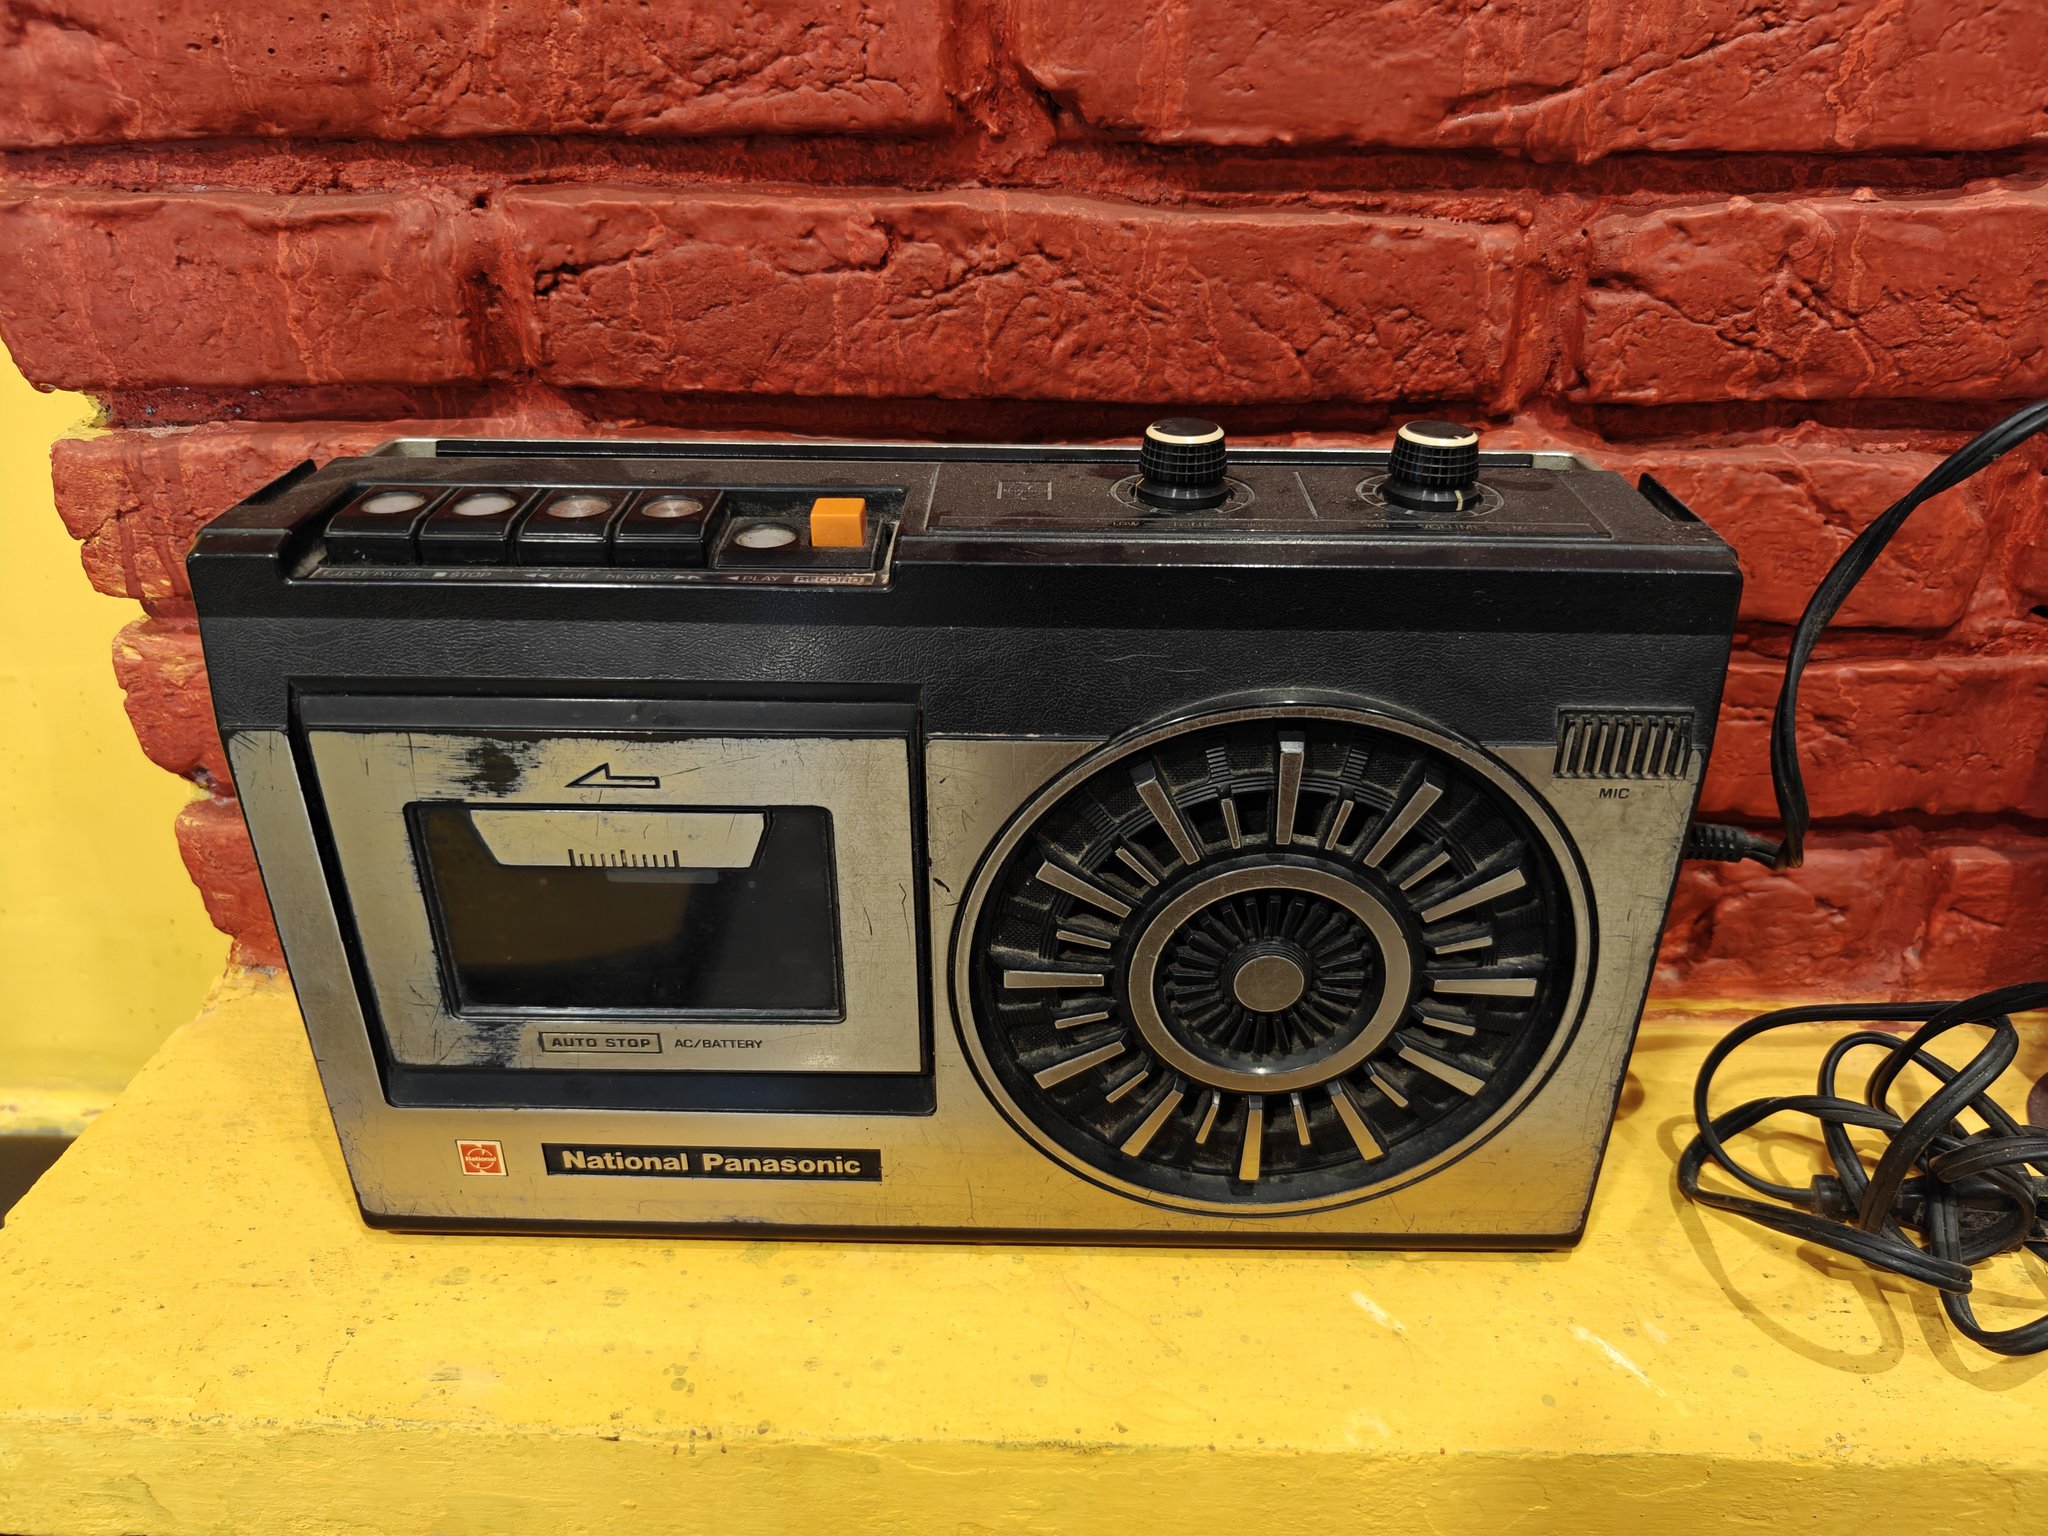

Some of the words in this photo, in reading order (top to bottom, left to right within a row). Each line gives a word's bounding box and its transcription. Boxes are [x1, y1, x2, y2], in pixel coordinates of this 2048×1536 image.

[1599, 788, 1630, 799] MIC
[551, 1038, 597, 1048] AUTO
[605, 1038, 651, 1048] STOP
[674, 1038, 763, 1049] AC/BATTERY
[561, 1150, 689, 1171] National
[703, 1152, 862, 1174] Panasonic
